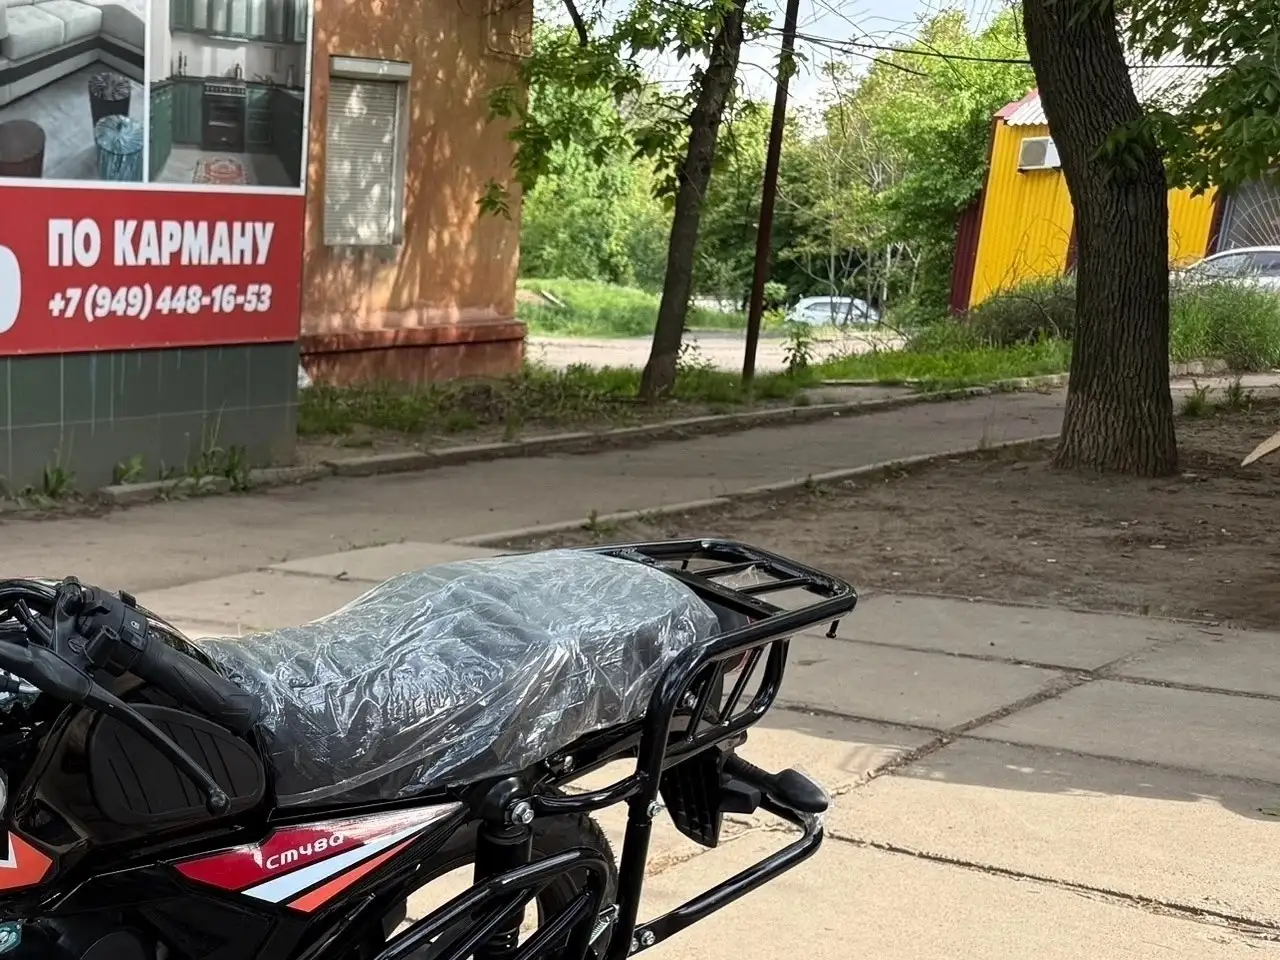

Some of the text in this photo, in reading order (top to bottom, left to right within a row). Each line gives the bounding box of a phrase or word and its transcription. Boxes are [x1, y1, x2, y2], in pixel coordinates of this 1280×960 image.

[47, 218, 275, 267] ПО КАРМАНУ
[48, 282, 273, 322] +7 (949) 448-16-53
